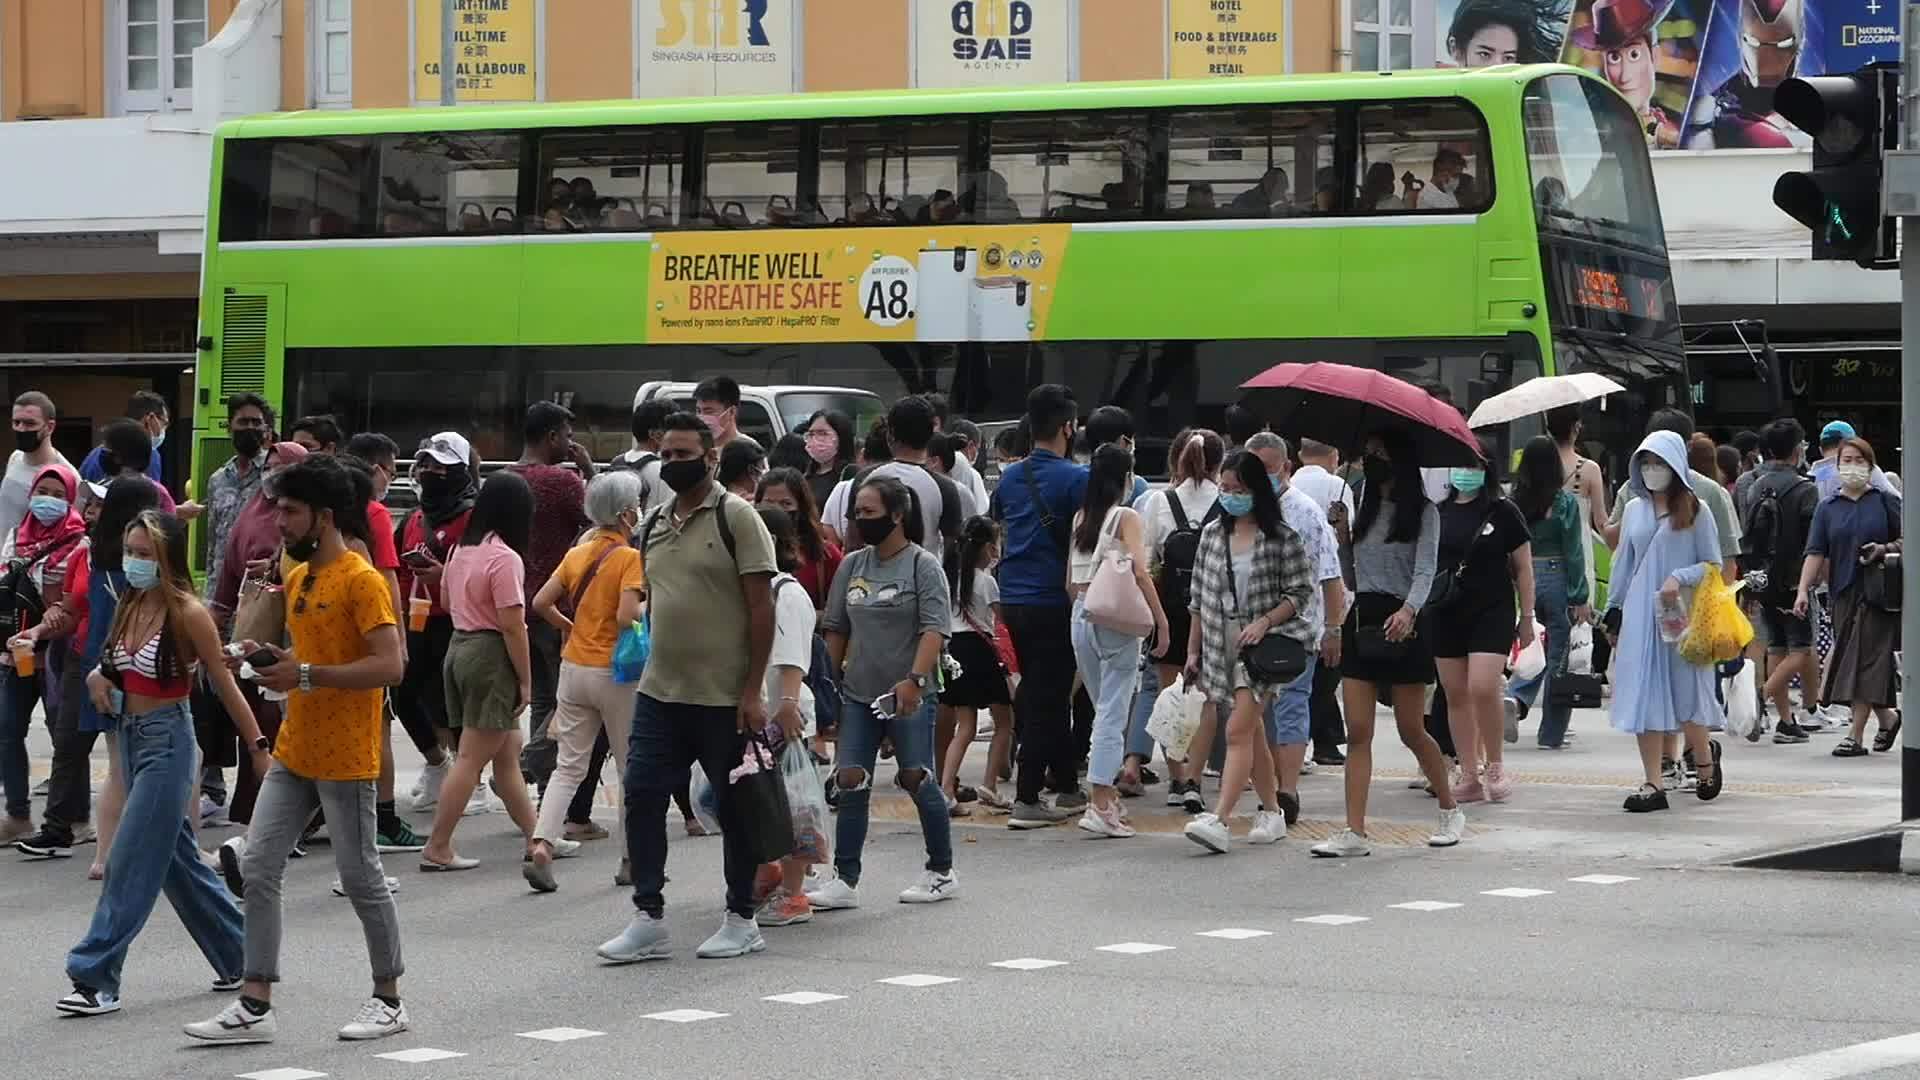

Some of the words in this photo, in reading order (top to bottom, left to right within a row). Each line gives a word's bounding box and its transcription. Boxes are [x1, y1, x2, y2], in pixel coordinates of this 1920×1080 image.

[1210, 0, 1242, 11] HOTEL
[1858, 26, 1896, 34] NATIONAL
[1174, 32, 1202, 42] FOOD
[1206, 32, 1215, 42] &
[1219, 32, 1277, 42] BEVERAGES
[953, 38, 1031, 60] SAE
[651, 51, 704, 62] SINGASIA
[707, 51, 777, 63] RESOURCES
[424, 63, 470, 74] CAAL
[476, 63, 526, 74] LABOUR
[963, 62, 1021, 70] AGENCY
[1208, 64, 1244, 74] RETAIL
[664, 253, 760, 282] BREATHE
[765, 250, 824, 279] WELL
[689, 282, 787, 312] BREATHE
[790, 281, 842, 310] SAFE
[661, 318, 693, 328] Powered
[694, 317, 703, 329] by
[820, 316, 841, 326] Filter
